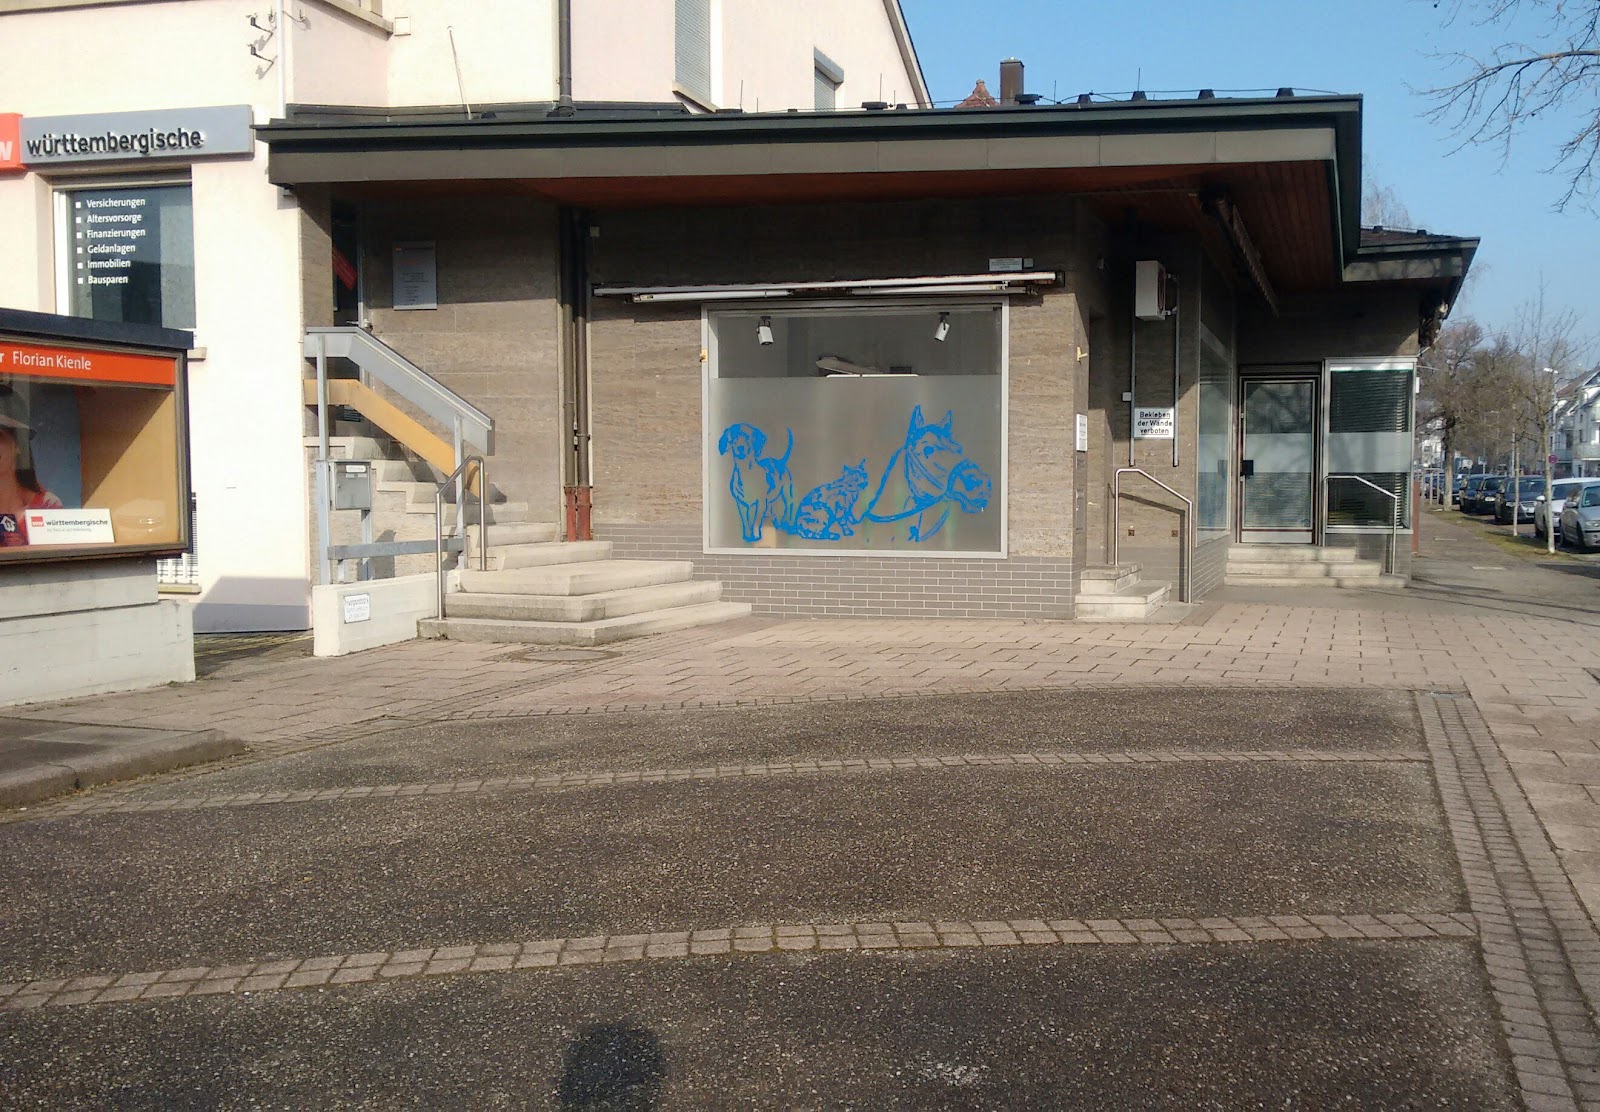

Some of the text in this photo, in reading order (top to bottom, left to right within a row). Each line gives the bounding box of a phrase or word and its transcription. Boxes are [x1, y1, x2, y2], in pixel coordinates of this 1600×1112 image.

[26, 127, 202, 154] württembergische
[86, 198, 146, 209] Versicherungen
[86, 213, 142, 224] Altersvorsorge
[86, 228, 146, 240] Finanzierungen
[87, 243, 136, 255] Geldanlagen
[87, 258, 131, 269] Immobilien
[88, 275, 129, 286] Bausparen
[13, 350, 54, 367] Florian
[56, 354, 92, 370] Kienle
[1137, 419, 1149, 427] der
